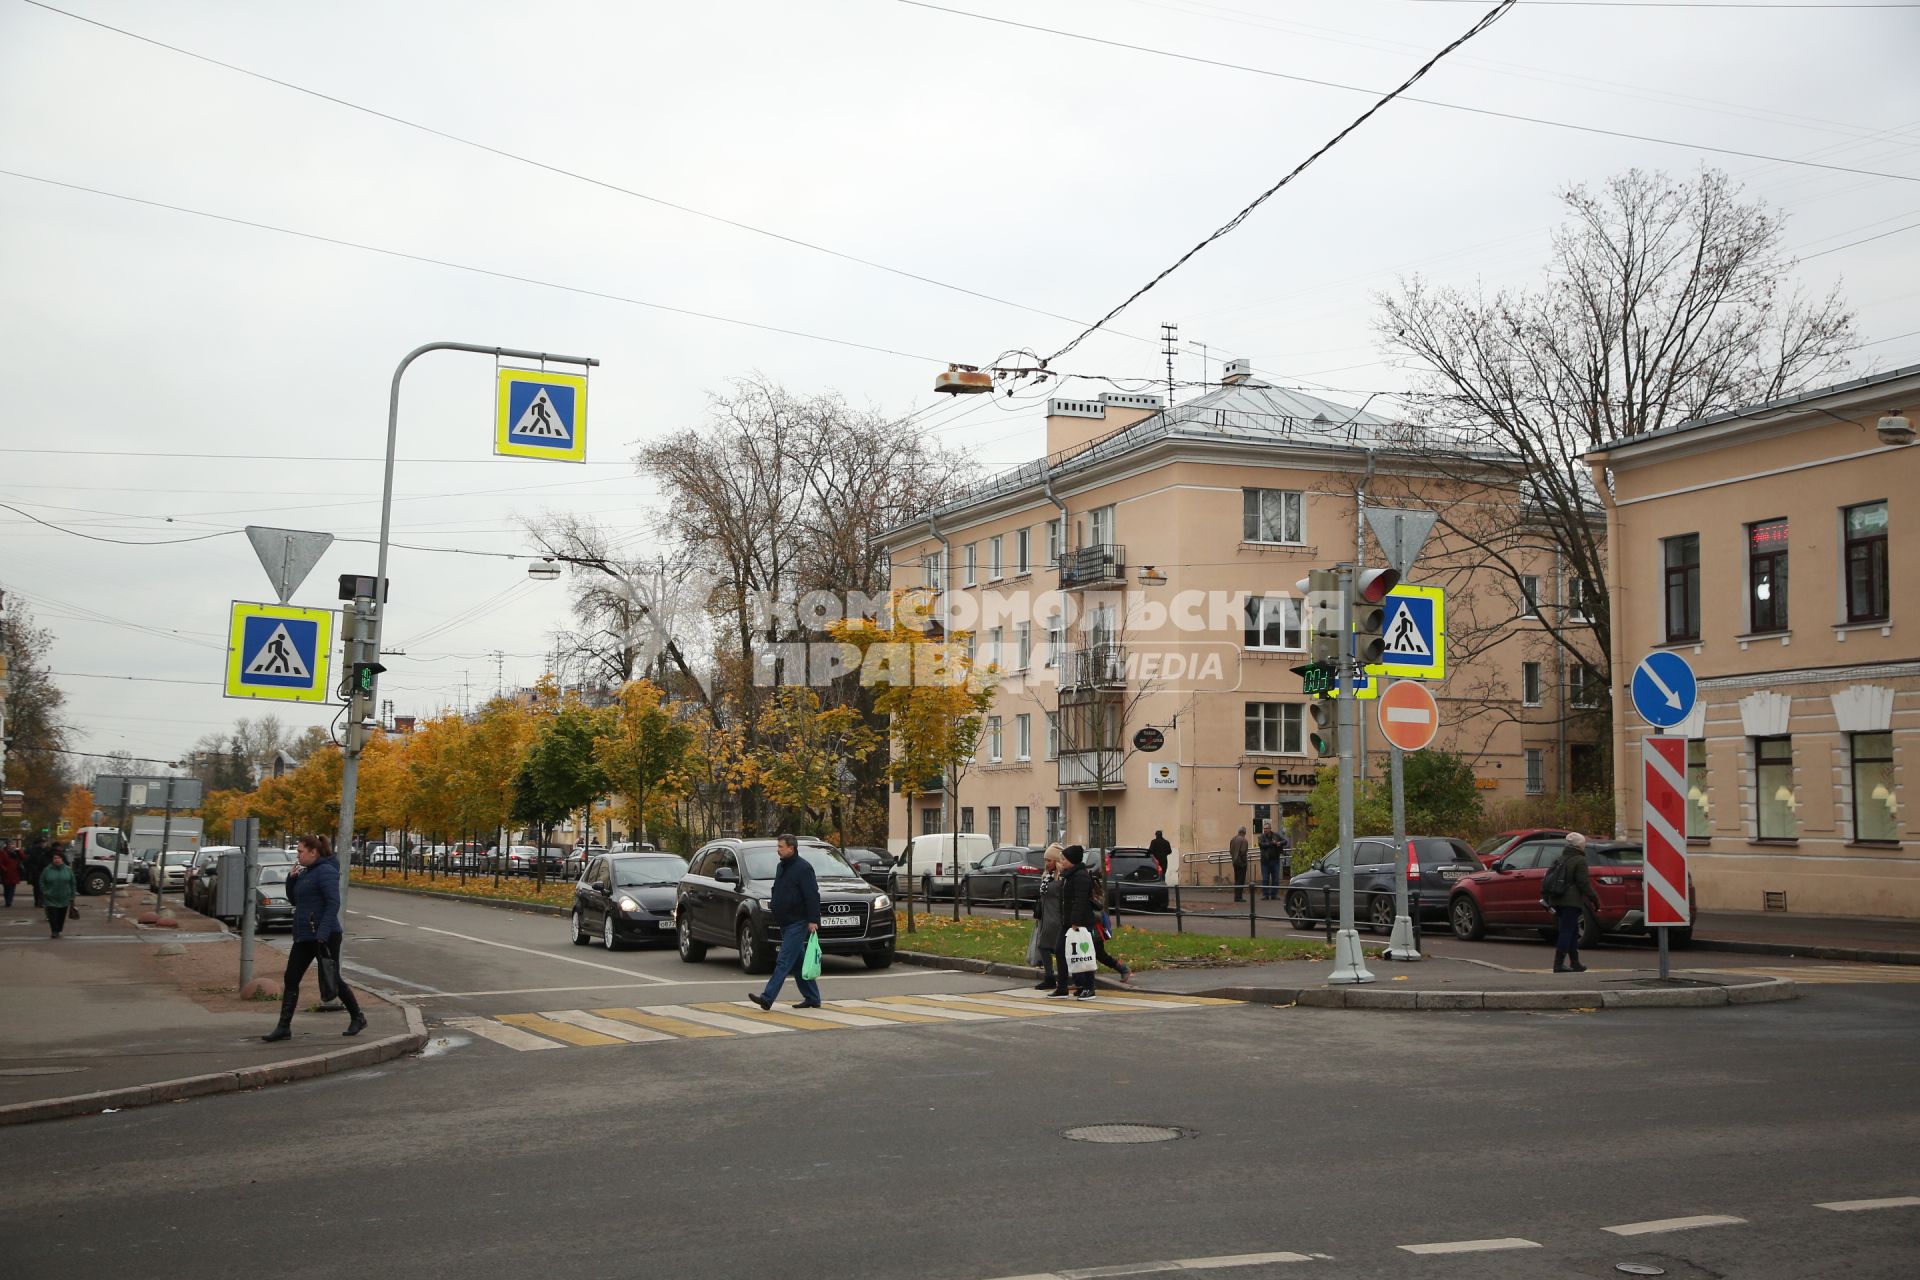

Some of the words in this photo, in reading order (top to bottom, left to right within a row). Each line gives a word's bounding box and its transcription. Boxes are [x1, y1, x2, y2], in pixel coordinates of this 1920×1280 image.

[1277, 769, 1319, 786] Била
[1071, 942, 1078, 956] I
[1070, 954, 1093, 964] green
